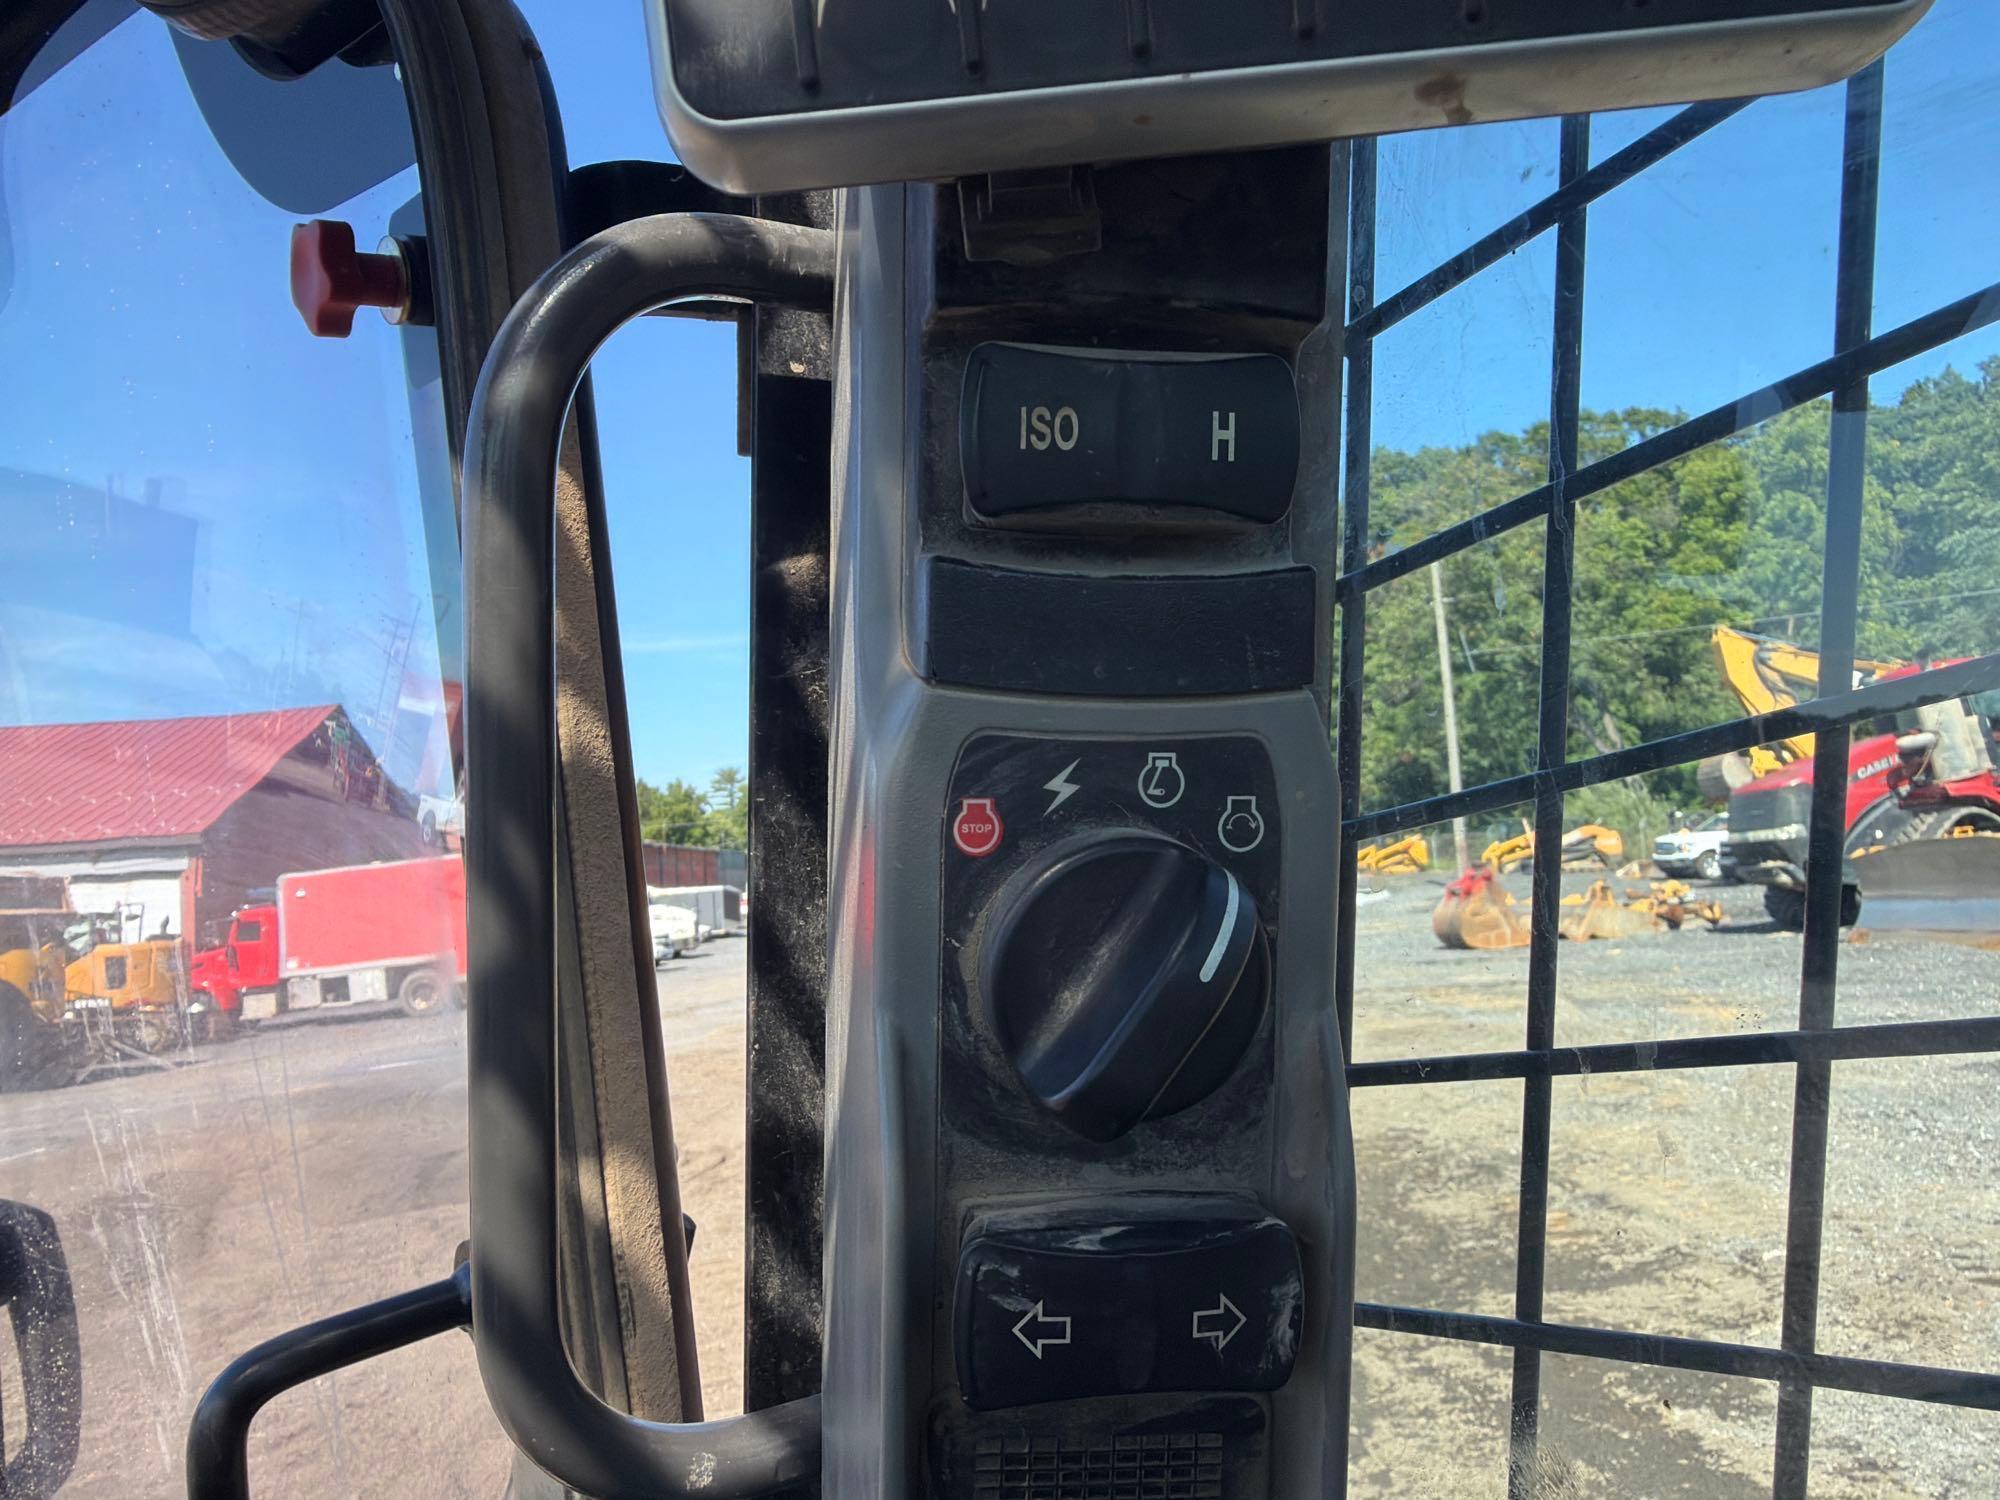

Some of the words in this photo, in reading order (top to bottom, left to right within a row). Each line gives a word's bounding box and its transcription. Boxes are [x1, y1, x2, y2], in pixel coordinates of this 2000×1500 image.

[1019, 405, 1079, 451] ISO
[1212, 410, 1236, 462] H
[961, 823, 992, 834] STOP
